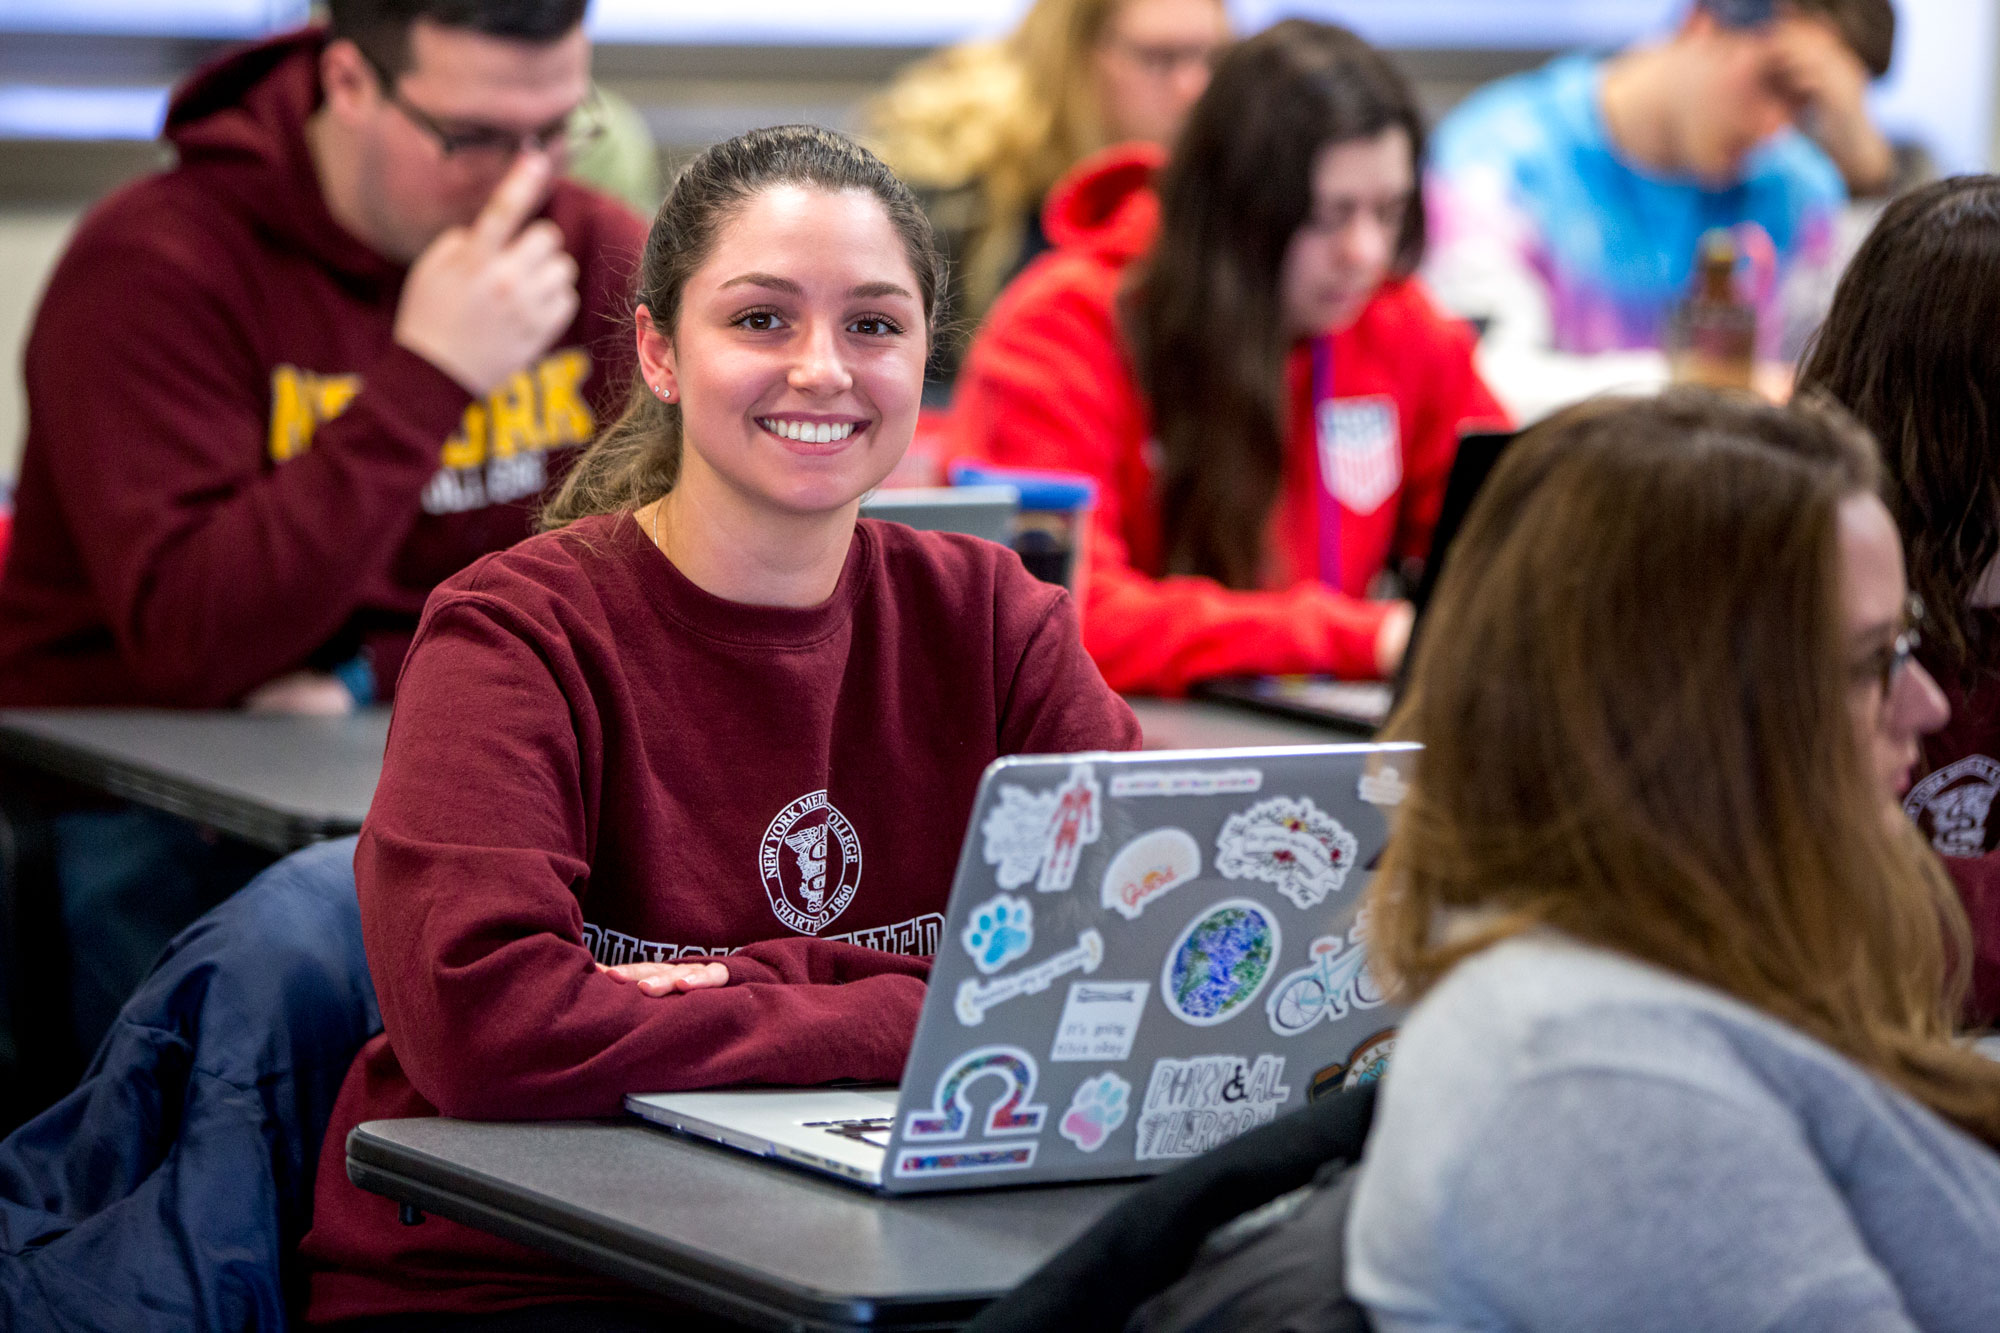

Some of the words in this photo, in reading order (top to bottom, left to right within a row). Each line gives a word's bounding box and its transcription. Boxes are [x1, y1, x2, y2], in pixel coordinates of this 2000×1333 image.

[767, 806, 801, 842] YORK
[763, 845, 778, 880] NEW
[828, 884, 853, 914] 1860
